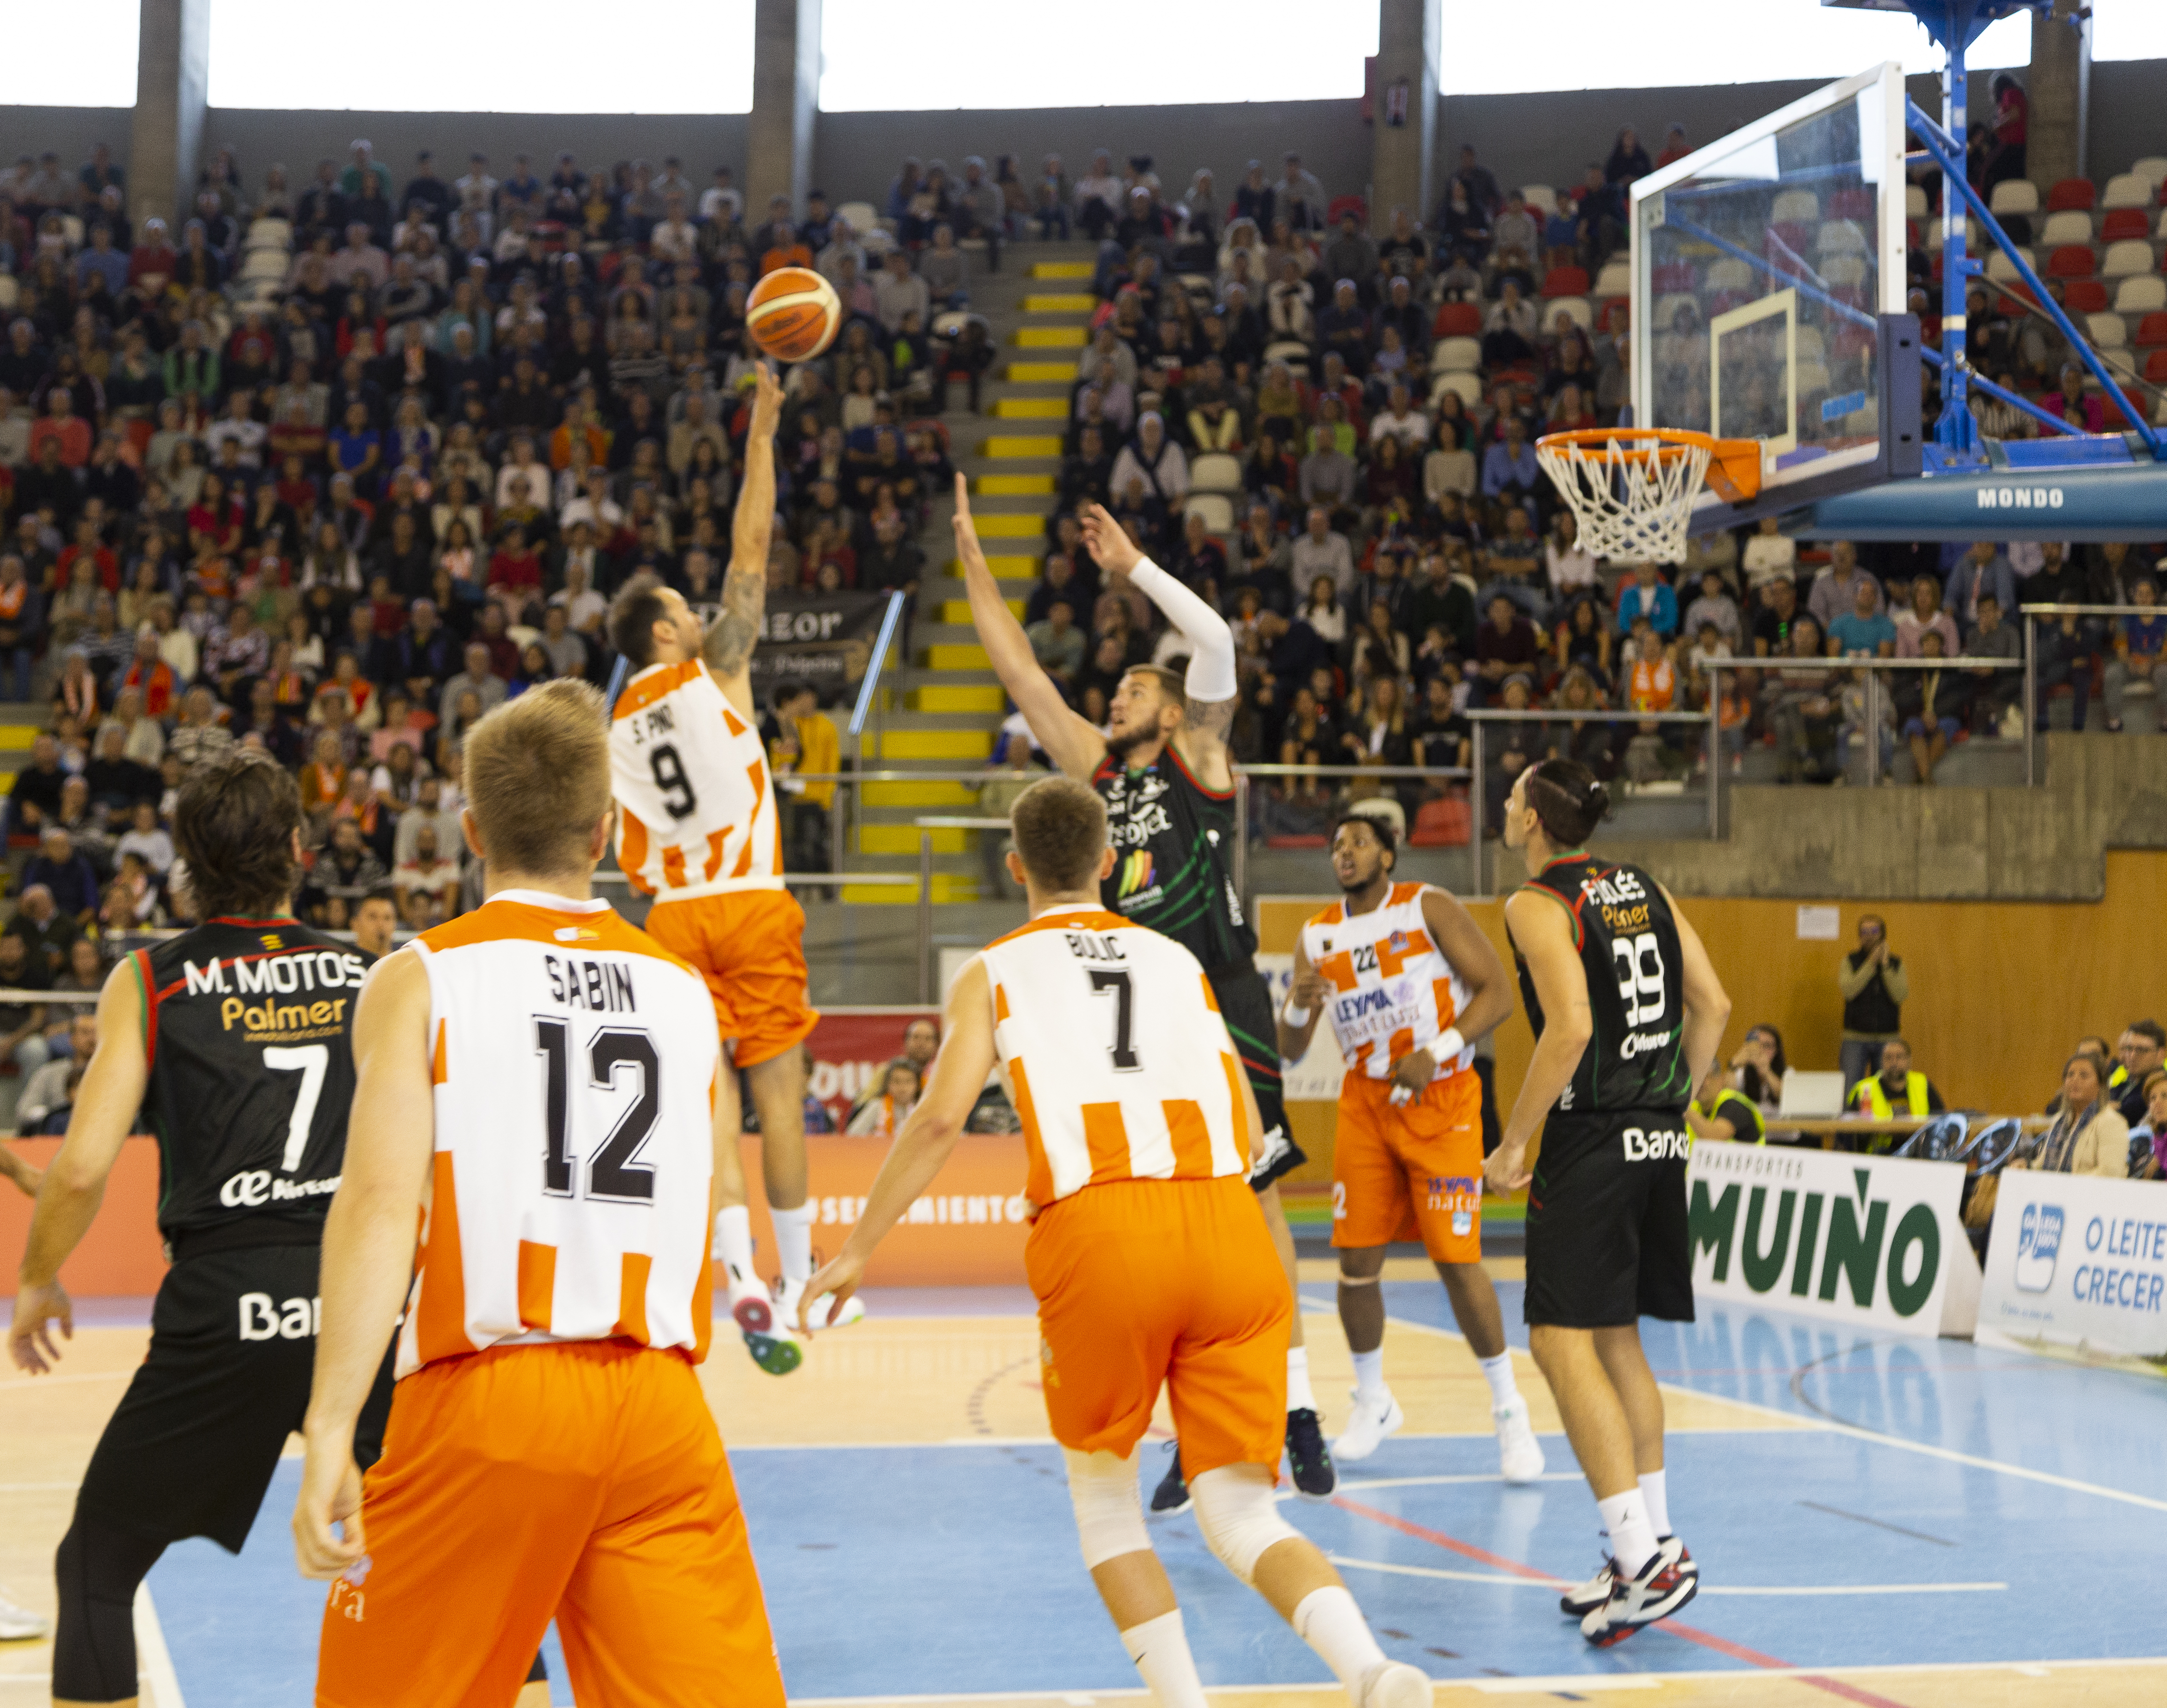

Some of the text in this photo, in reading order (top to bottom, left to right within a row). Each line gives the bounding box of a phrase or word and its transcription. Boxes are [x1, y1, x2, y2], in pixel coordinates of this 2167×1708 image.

[1977, 488, 2063, 509] MONDO
[648, 742, 697, 822] 9
[545, 954, 636, 1013] SABIN
[1354, 944, 1377, 973] 22
[221, 996, 348, 1031] Palmer
[1082, 965, 1144, 1073] 7
[263, 1043, 329, 1173] 7
[531, 1013, 663, 1207] 12
[1697, 1148, 1804, 1180] TRANSPORTES
[1688, 1168, 1941, 1319] MUIÑO
[2085, 1216, 2167, 1261] O LEITE
[2073, 1263, 2166, 1313] CRECER
